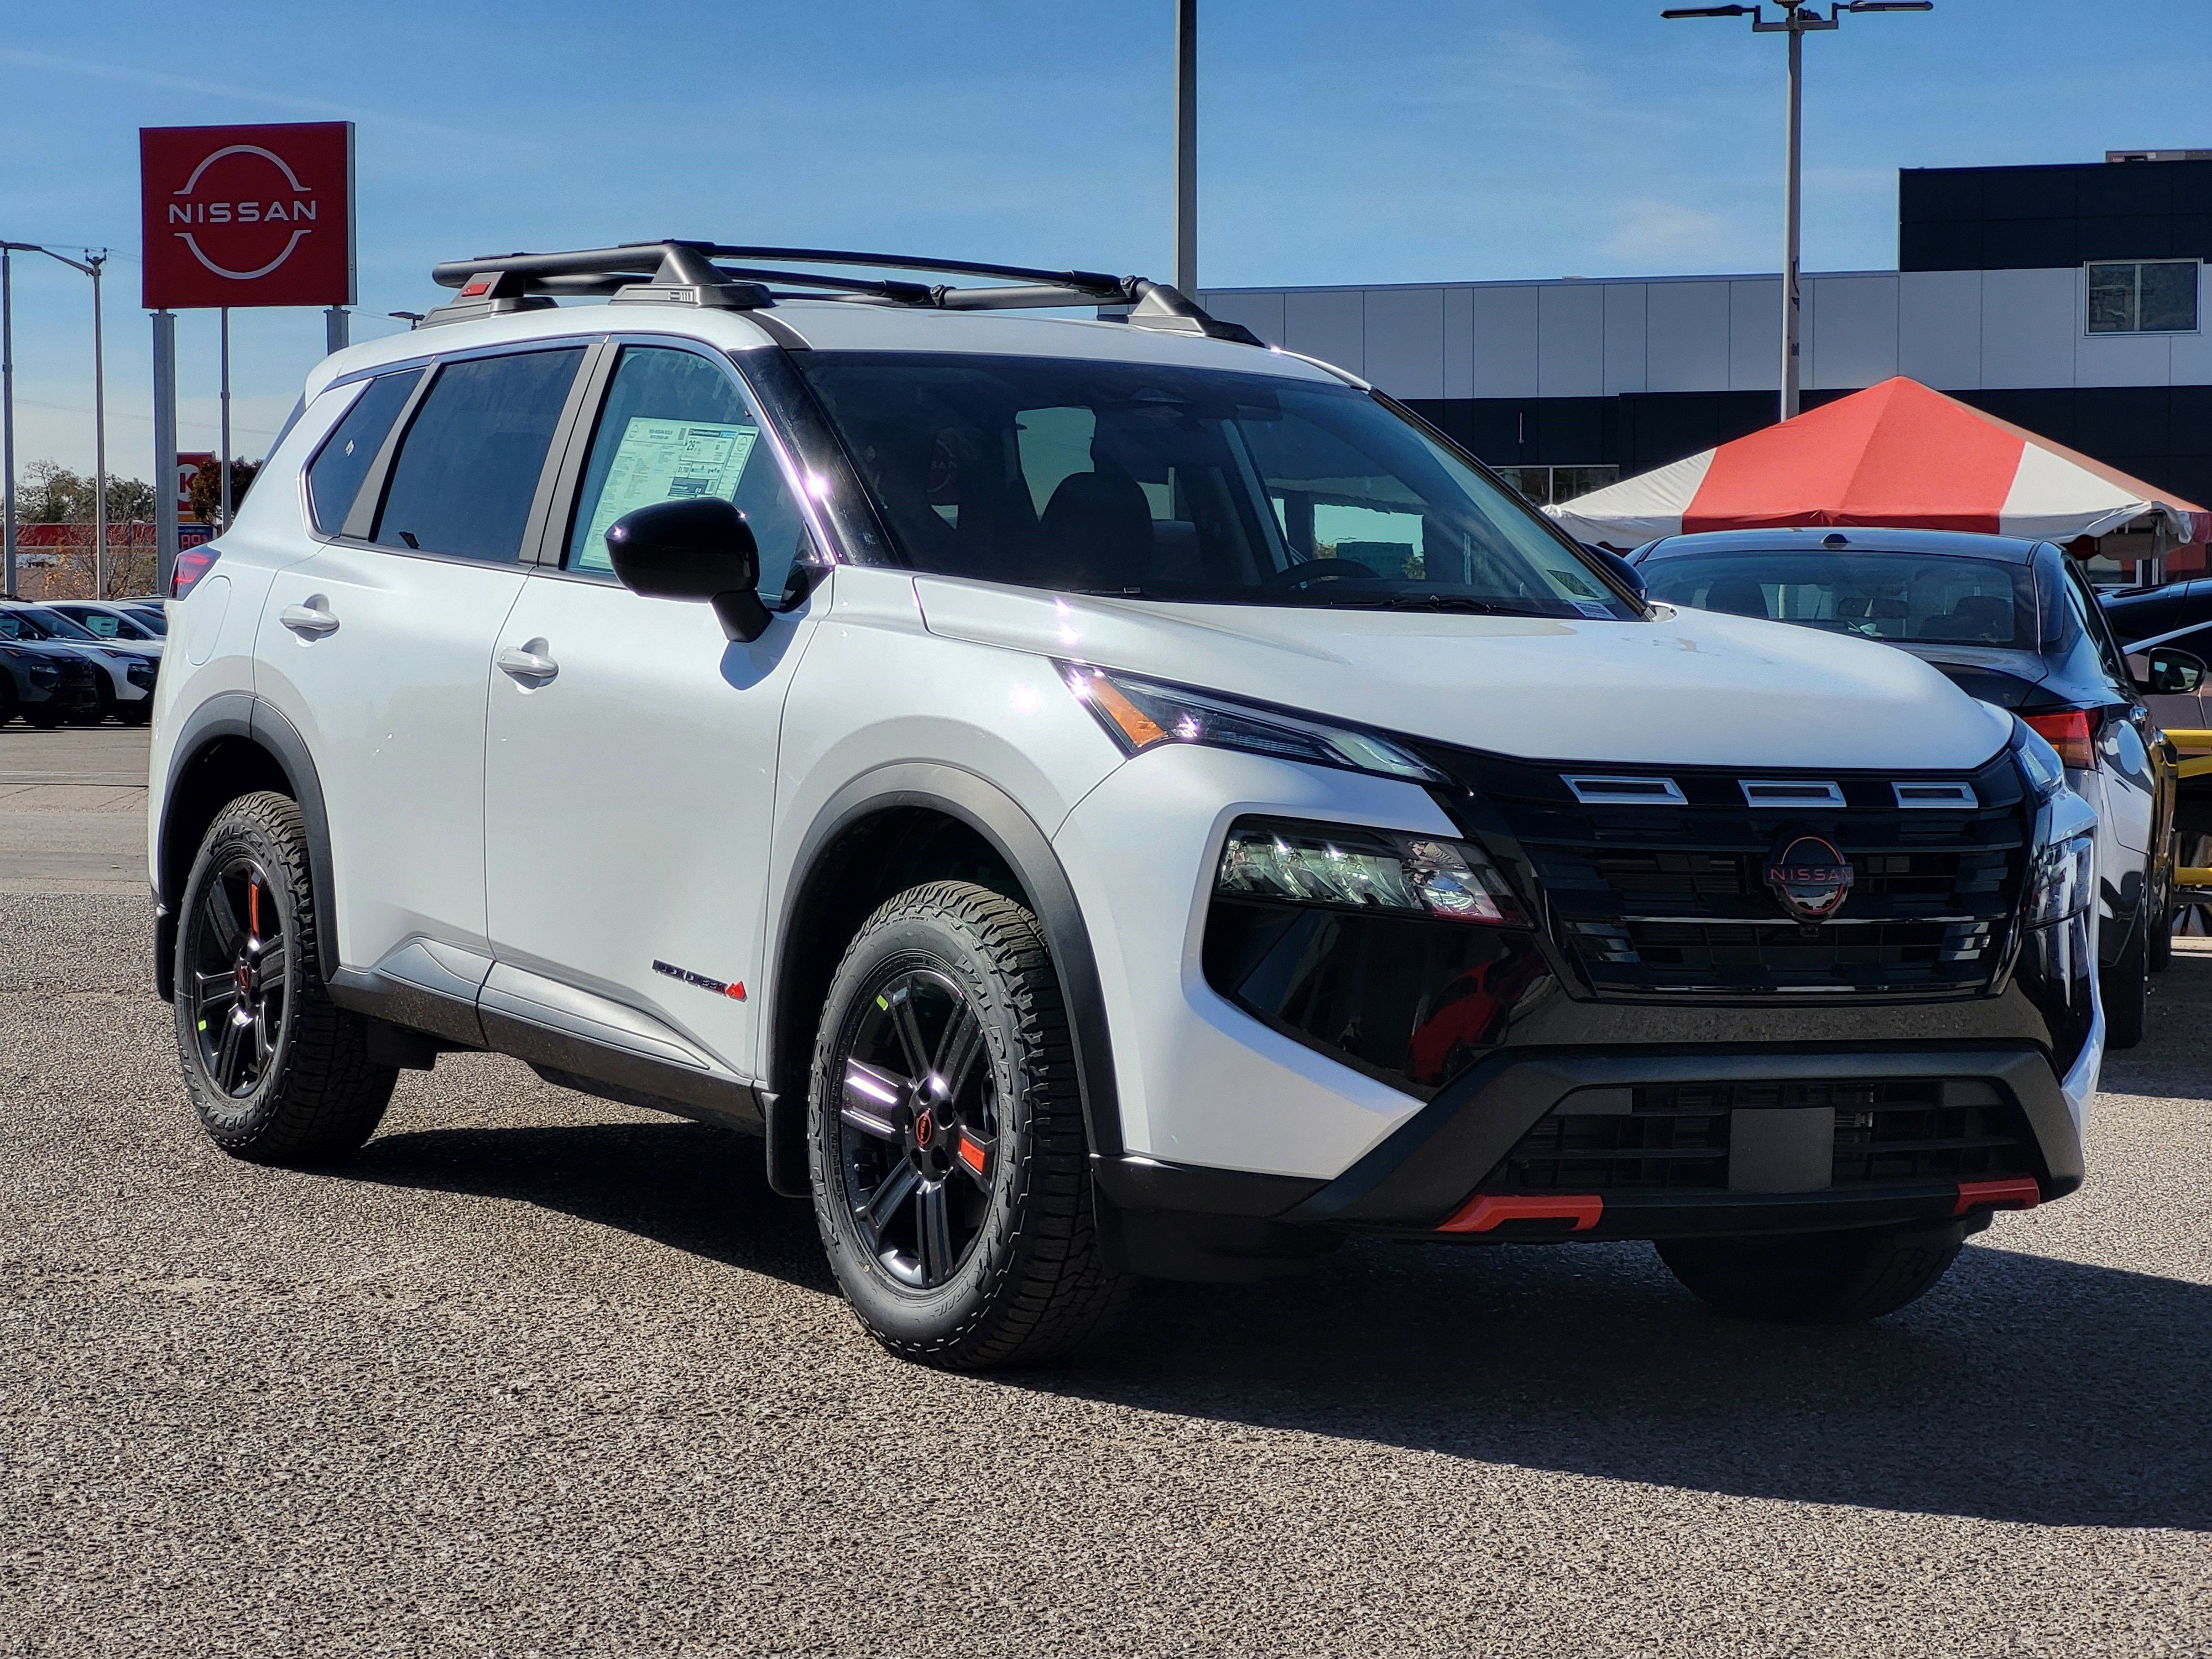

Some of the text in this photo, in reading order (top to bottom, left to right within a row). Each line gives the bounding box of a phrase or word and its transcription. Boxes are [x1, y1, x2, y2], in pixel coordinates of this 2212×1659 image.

[169, 200, 316, 223] NISSAN
[686, 440, 696, 451] 29
[180, 473, 199, 493] K
[1770, 868, 1853, 881] NISSAN
[954, 954, 1015, 1208] WILDPEAK
